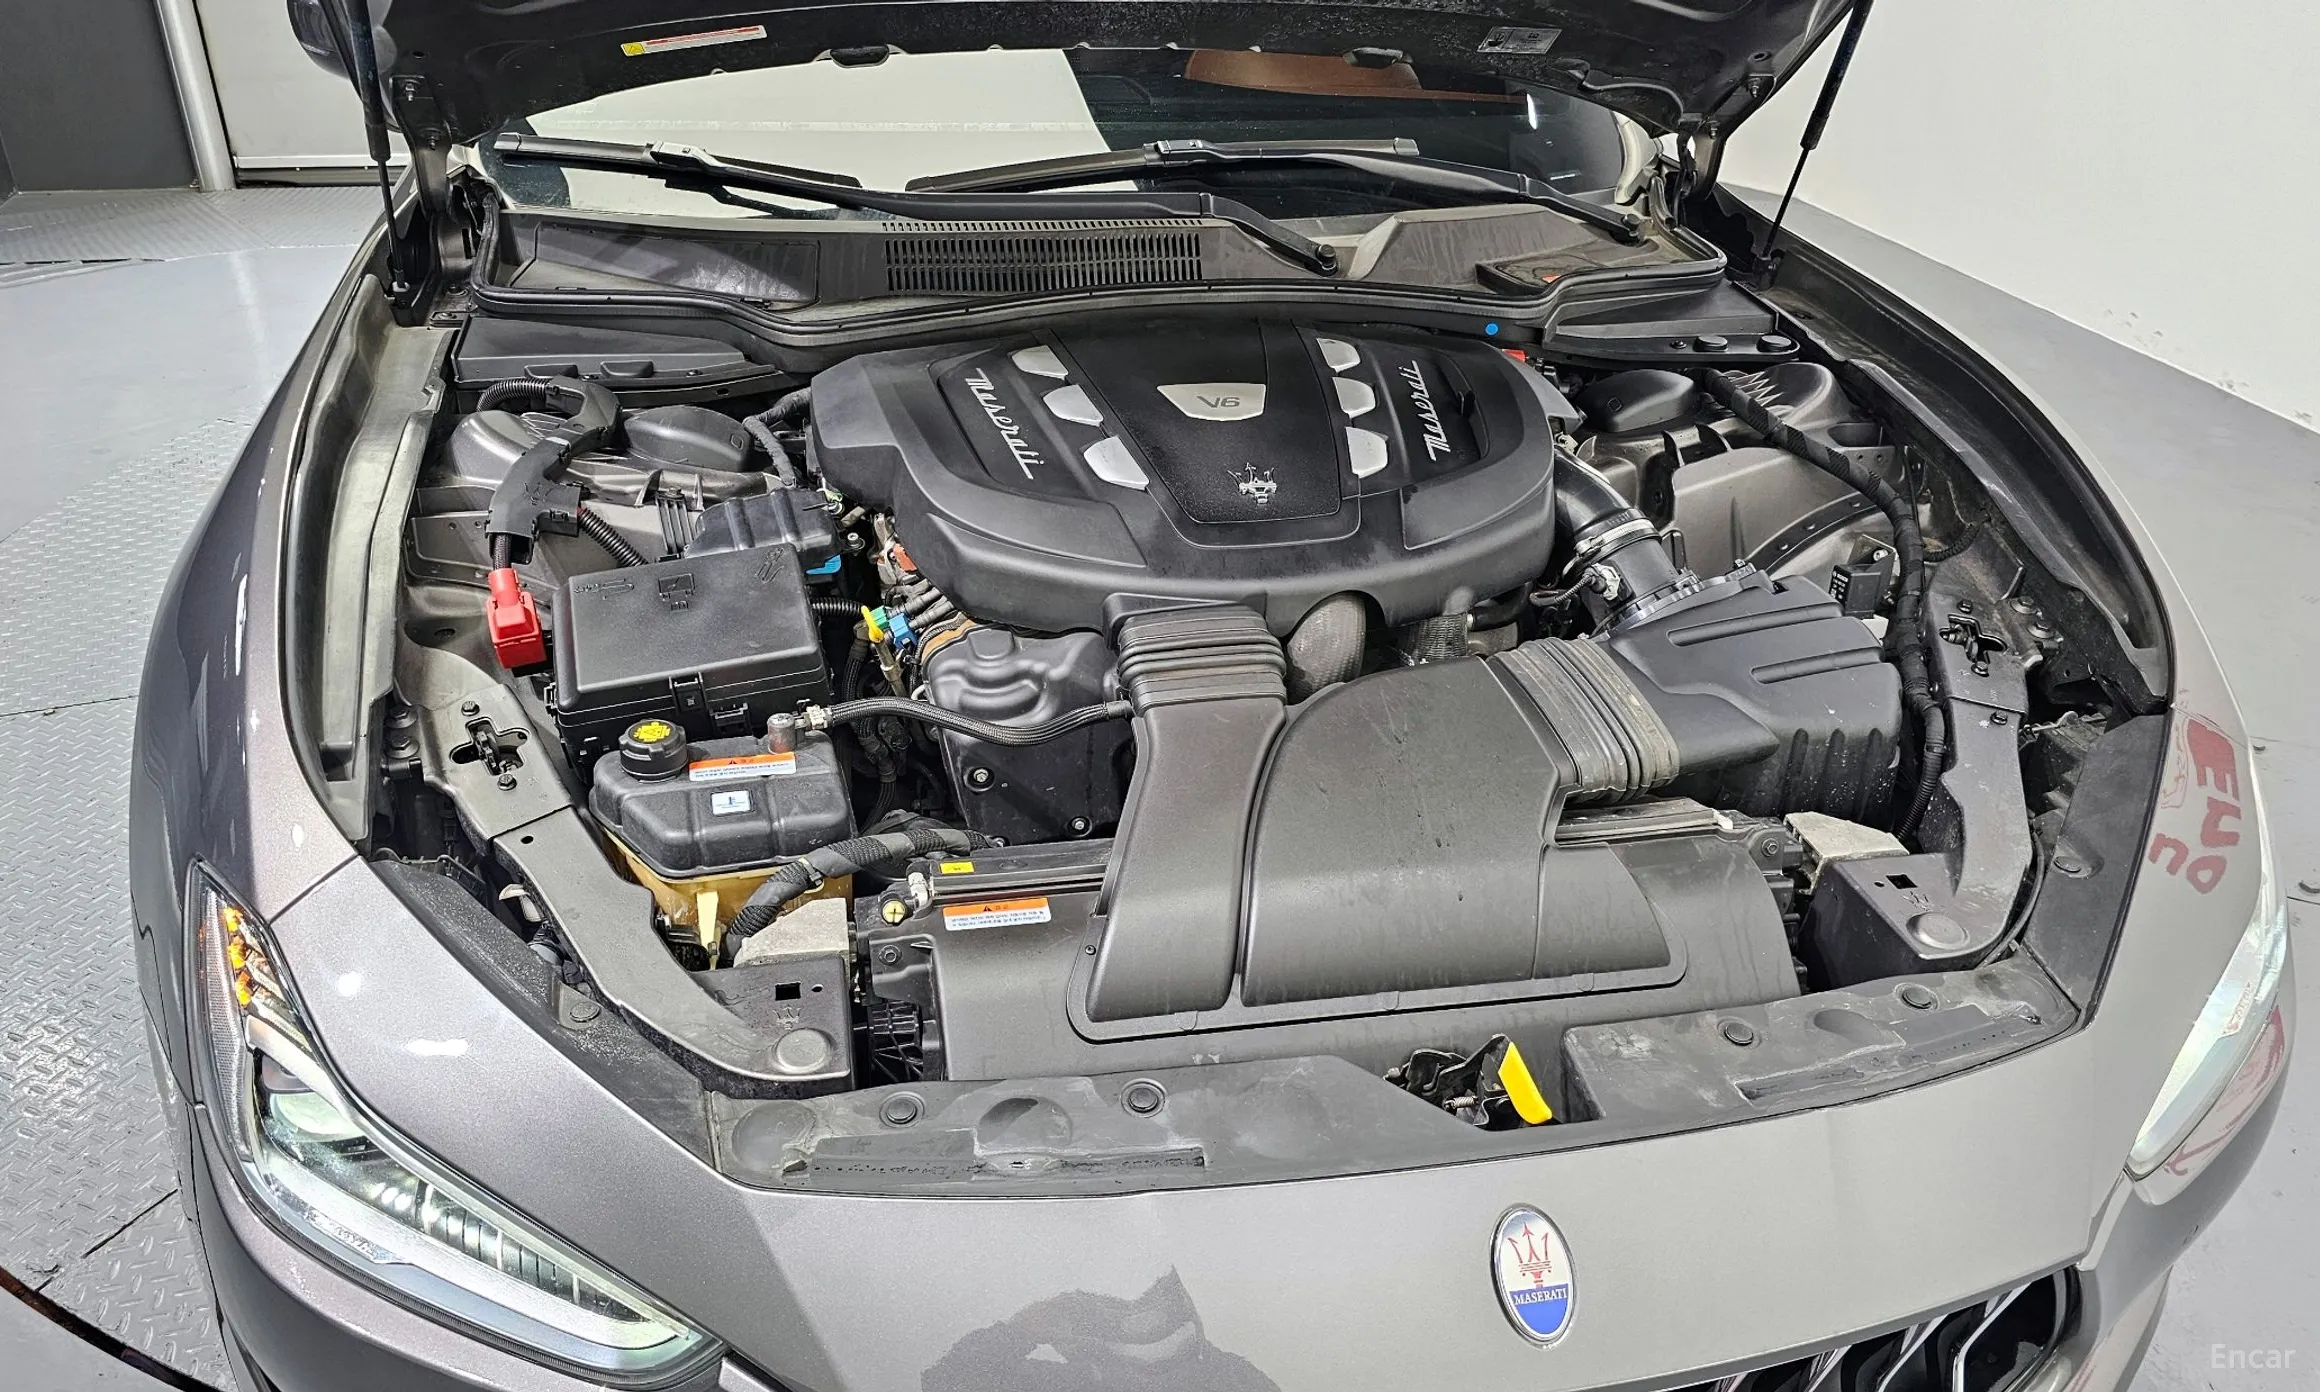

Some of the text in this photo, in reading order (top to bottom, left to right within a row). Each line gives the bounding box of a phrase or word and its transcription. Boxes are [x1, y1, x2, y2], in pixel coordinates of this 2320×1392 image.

[965, 367, 1044, 480] Maserati
[1196, 395, 1240, 408] V6
[1398, 360, 1451, 461] Maserati
[1514, 1288, 1567, 1306] MASERATI
